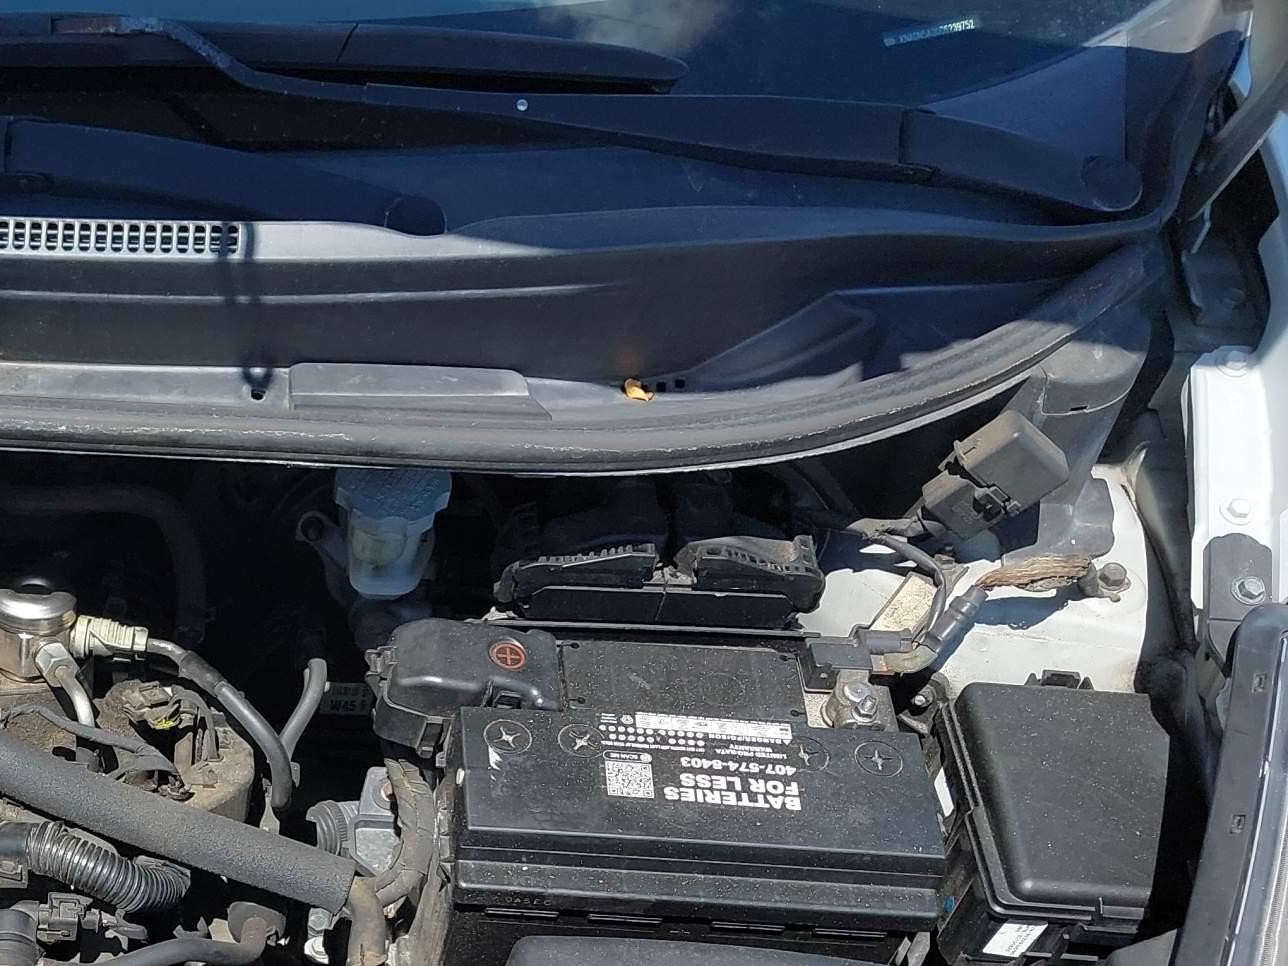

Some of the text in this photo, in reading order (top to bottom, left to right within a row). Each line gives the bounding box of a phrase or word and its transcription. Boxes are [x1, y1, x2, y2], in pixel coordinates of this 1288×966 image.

[729, 743, 772, 752] WARRANTY
[755, 750, 787, 760] LIMITED
[609, 751, 641, 760] SCAN ME
[680, 756, 797, 776] 407-574-8403
[679, 772, 800, 796] FOR LESS
[663, 786, 802, 811] BATTERIES
